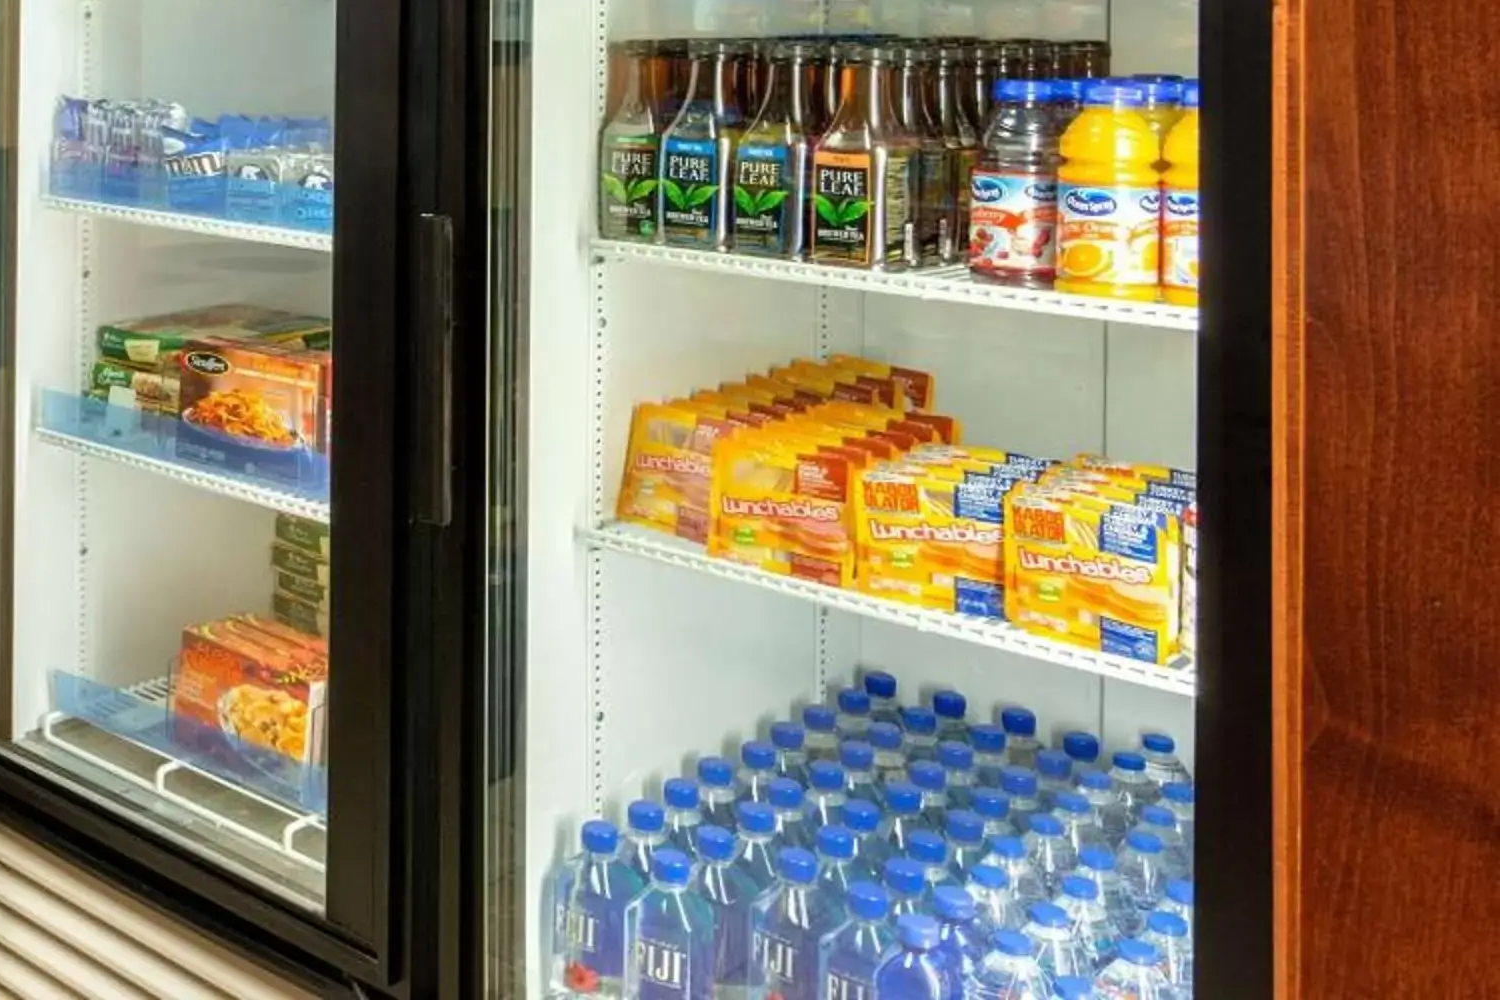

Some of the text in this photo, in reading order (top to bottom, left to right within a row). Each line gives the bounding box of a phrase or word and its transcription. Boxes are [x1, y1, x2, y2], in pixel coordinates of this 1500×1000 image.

[612, 150, 653, 164] PURE
[669, 154, 710, 170] PURE
[611, 162, 652, 176] LEAF
[669, 167, 710, 182] LEAF
[740, 160, 781, 175] PURE
[739, 173, 779, 186] LEAF
[819, 168, 865, 184] PURE
[819, 181, 864, 197] LEAF
[635, 453, 711, 477] Lunchable
[723, 496, 839, 521] Lunchables
[1018, 546, 1152, 584] Lunchables
[636, 940, 682, 985] FIJI
[753, 931, 793, 980] FIJI
